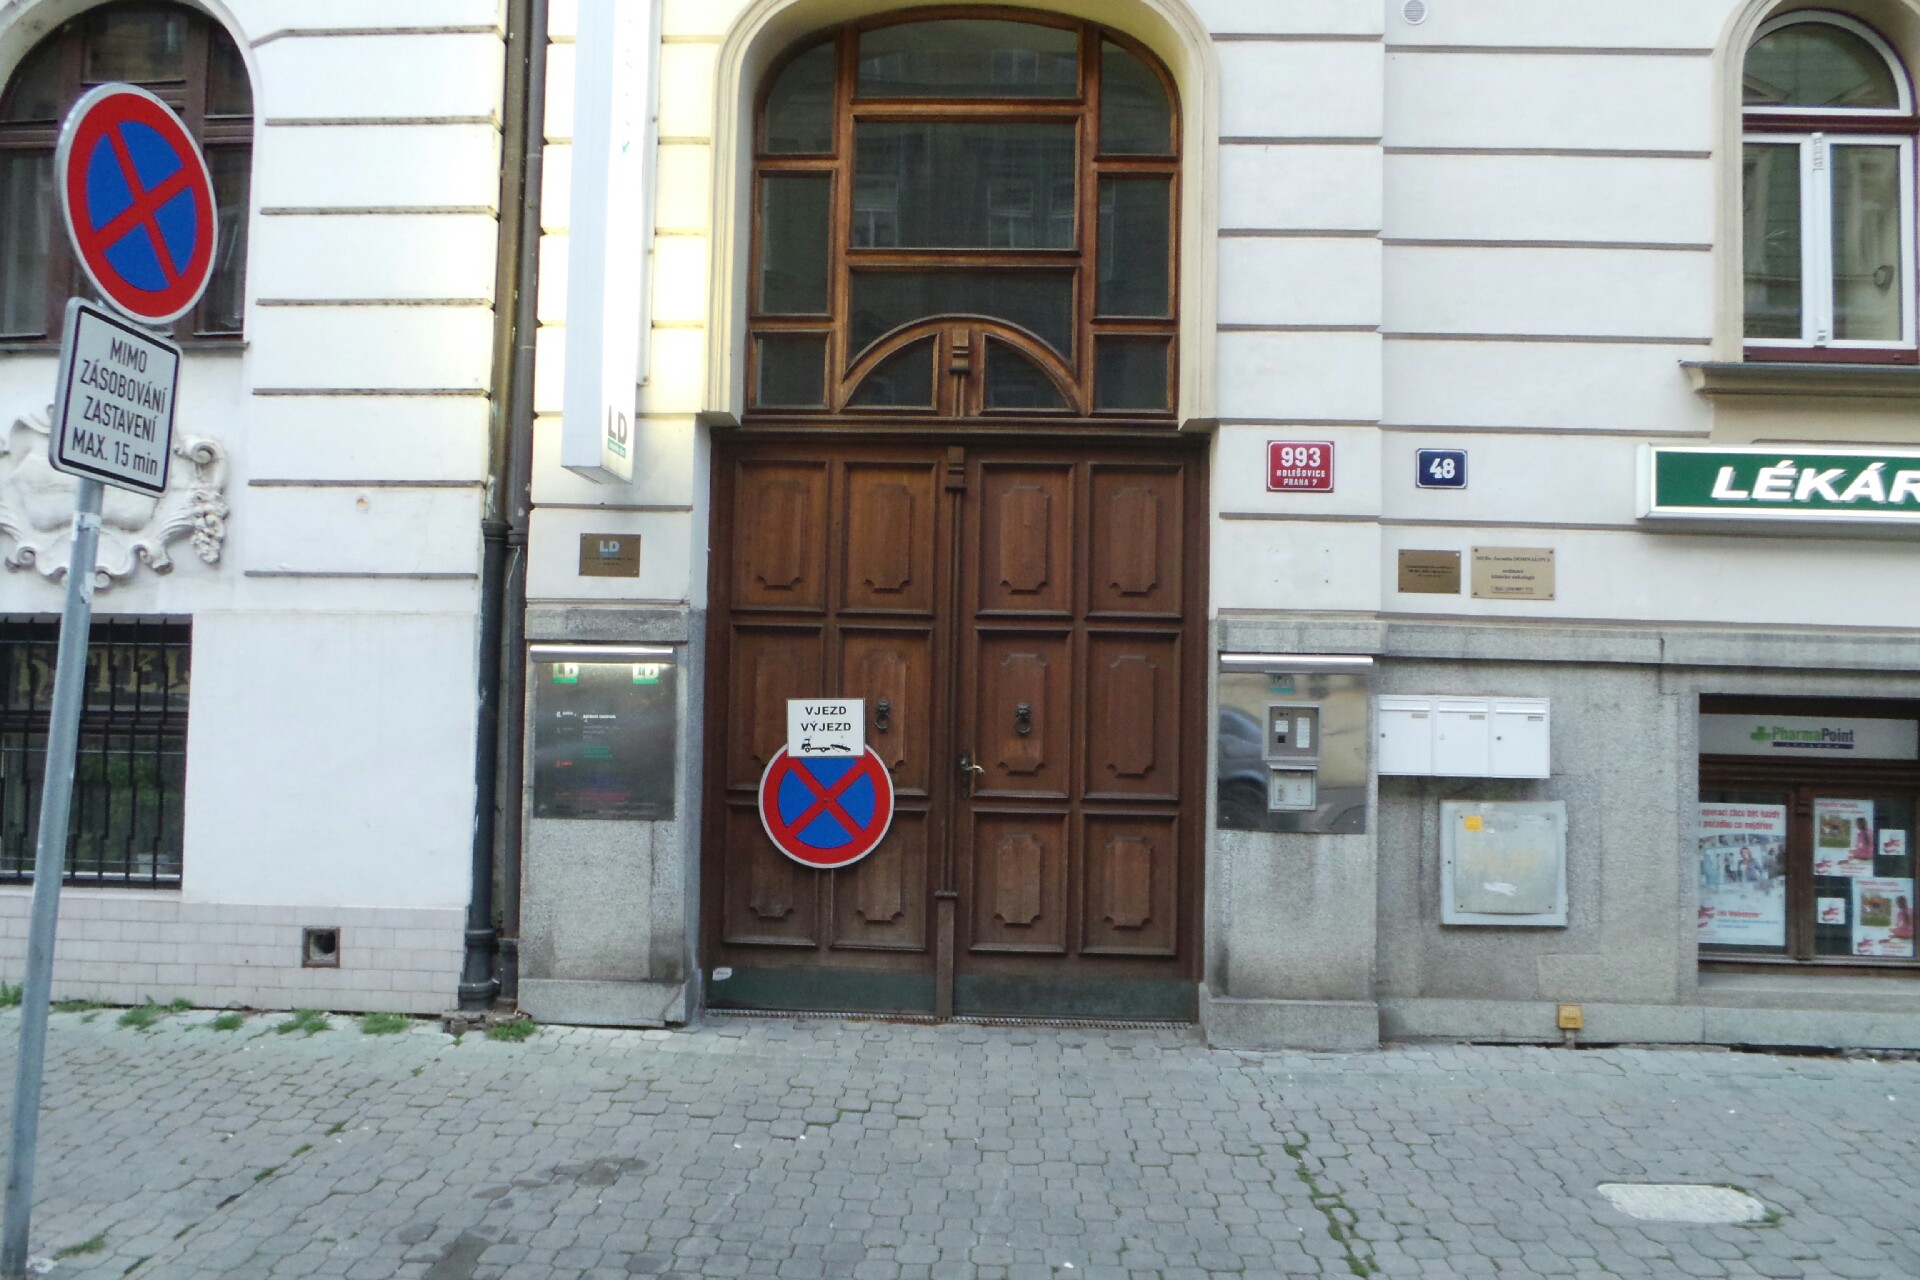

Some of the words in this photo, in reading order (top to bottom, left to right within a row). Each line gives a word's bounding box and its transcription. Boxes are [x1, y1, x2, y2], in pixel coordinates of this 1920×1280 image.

[109, 337, 148, 373] MIMO
[80, 359, 168, 414] ZÁSOBOVÁNÍ
[83, 395, 158, 443] ZASTAVENÍ
[607, 404, 628, 445] LD
[72, 427, 108, 461] MAX.
[114, 441, 130, 467] 15
[133, 452, 158, 476] min
[1281, 447, 1321, 467] 993
[1276, 468, 1326, 478] HOLEŠOVICE
[1429, 458, 1455, 479] 48
[1710, 459, 1920, 504] LÉKÁR
[599, 540, 620, 552] LD
[805, 706, 847, 715] VJEZD
[800, 721, 852, 732] VÝJEZD
[1771, 725, 1855, 743] PharmaPoint
